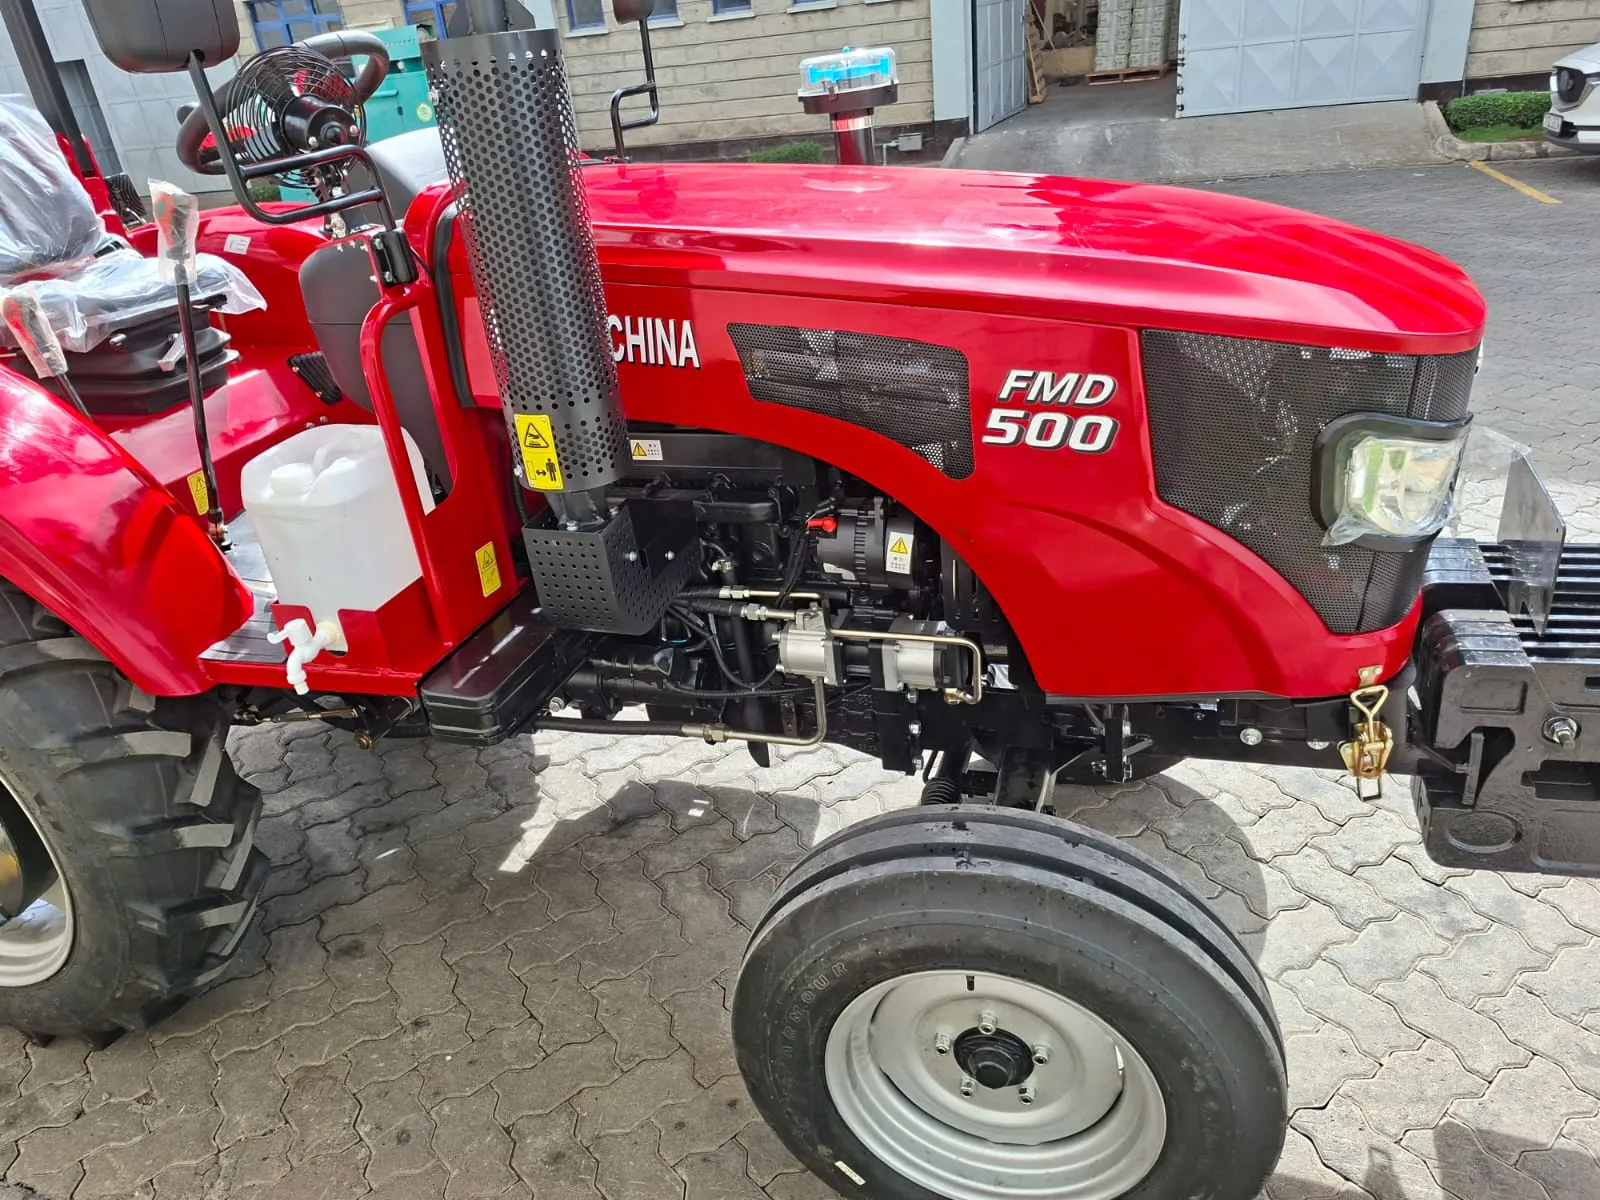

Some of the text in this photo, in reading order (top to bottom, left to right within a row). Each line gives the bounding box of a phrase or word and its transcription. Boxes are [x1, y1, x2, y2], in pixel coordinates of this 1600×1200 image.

[608, 314, 701, 369] CHINA
[996, 369, 1118, 408] FMD
[981, 408, 1121, 454] 500
[782, 962, 848, 1059] ARMOUR
